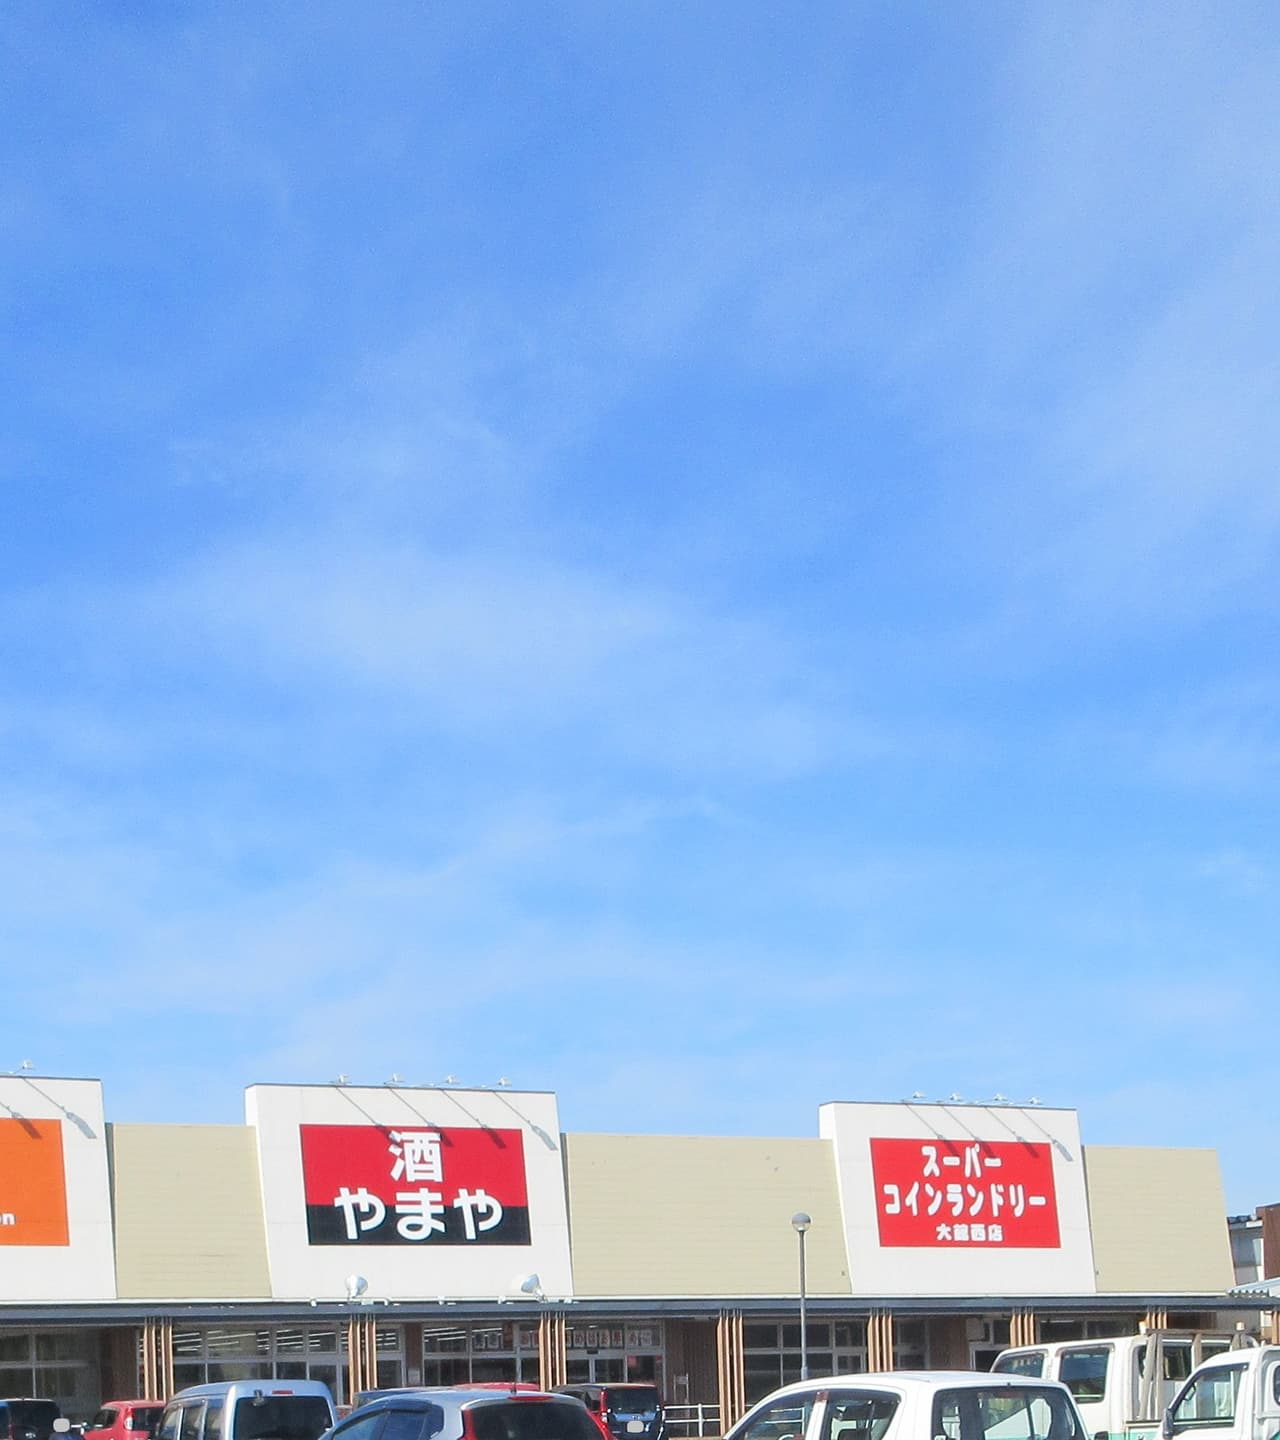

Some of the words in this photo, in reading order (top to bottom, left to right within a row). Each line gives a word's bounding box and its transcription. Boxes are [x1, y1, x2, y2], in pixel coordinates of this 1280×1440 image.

[388, 1130, 444, 1182] 酒
[921, 1143, 1002, 1178] スーパー
[333, 1187, 504, 1240] やまや
[883, 1181, 1047, 1217] コインランドリー
